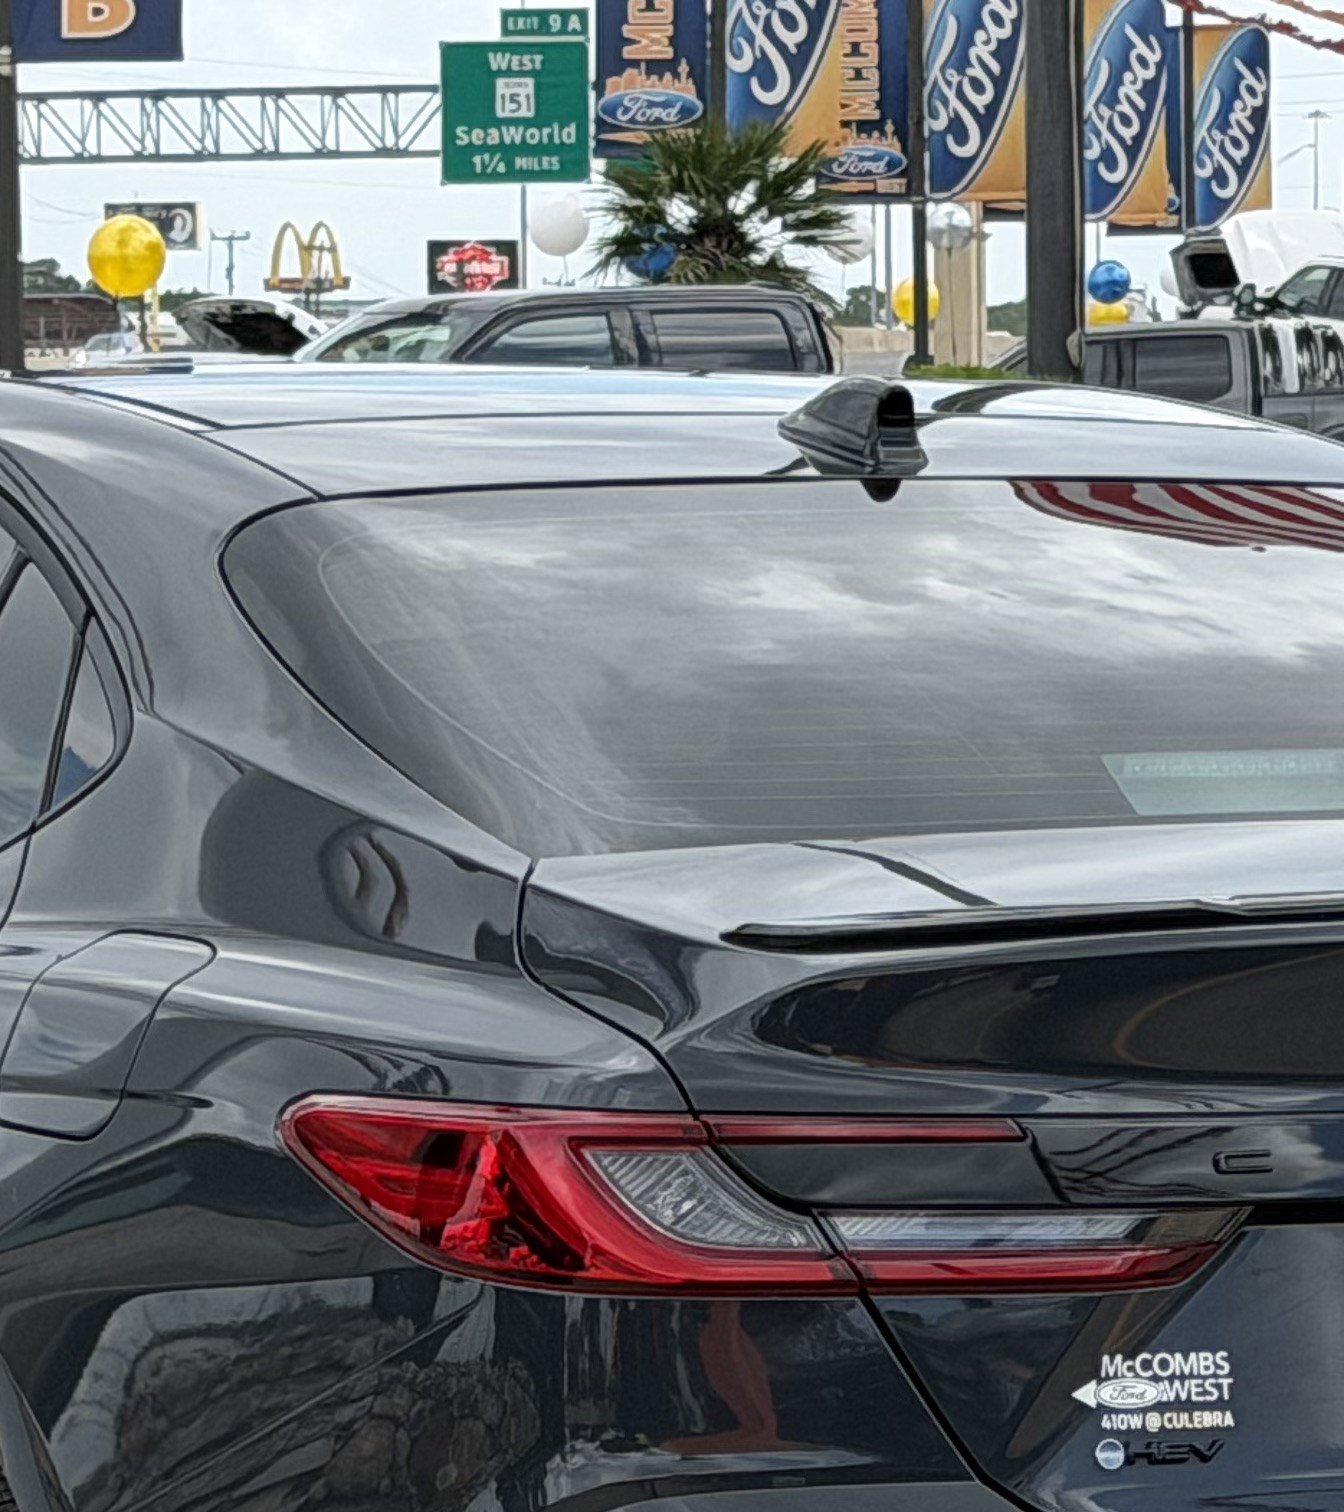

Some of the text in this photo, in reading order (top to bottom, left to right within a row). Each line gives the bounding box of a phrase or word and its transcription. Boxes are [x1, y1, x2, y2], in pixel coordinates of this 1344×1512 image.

[507, 16, 539, 31] EXIT
[488, 52, 544, 71] WEST
[926, 0, 1019, 159] Ford
[500, 93, 532, 114] 151
[617, 94, 683, 121] Ford
[1084, 22, 1163, 184] Ford
[455, 122, 577, 146] SeaWorld
[1193, 56, 1268, 199] Ford
[515, 156, 560, 171] MILES
[831, 150, 890, 174] Ford
[1101, 1351, 1231, 1378] McCOMBS
[1109, 1378, 1234, 1402] Ford WEST
